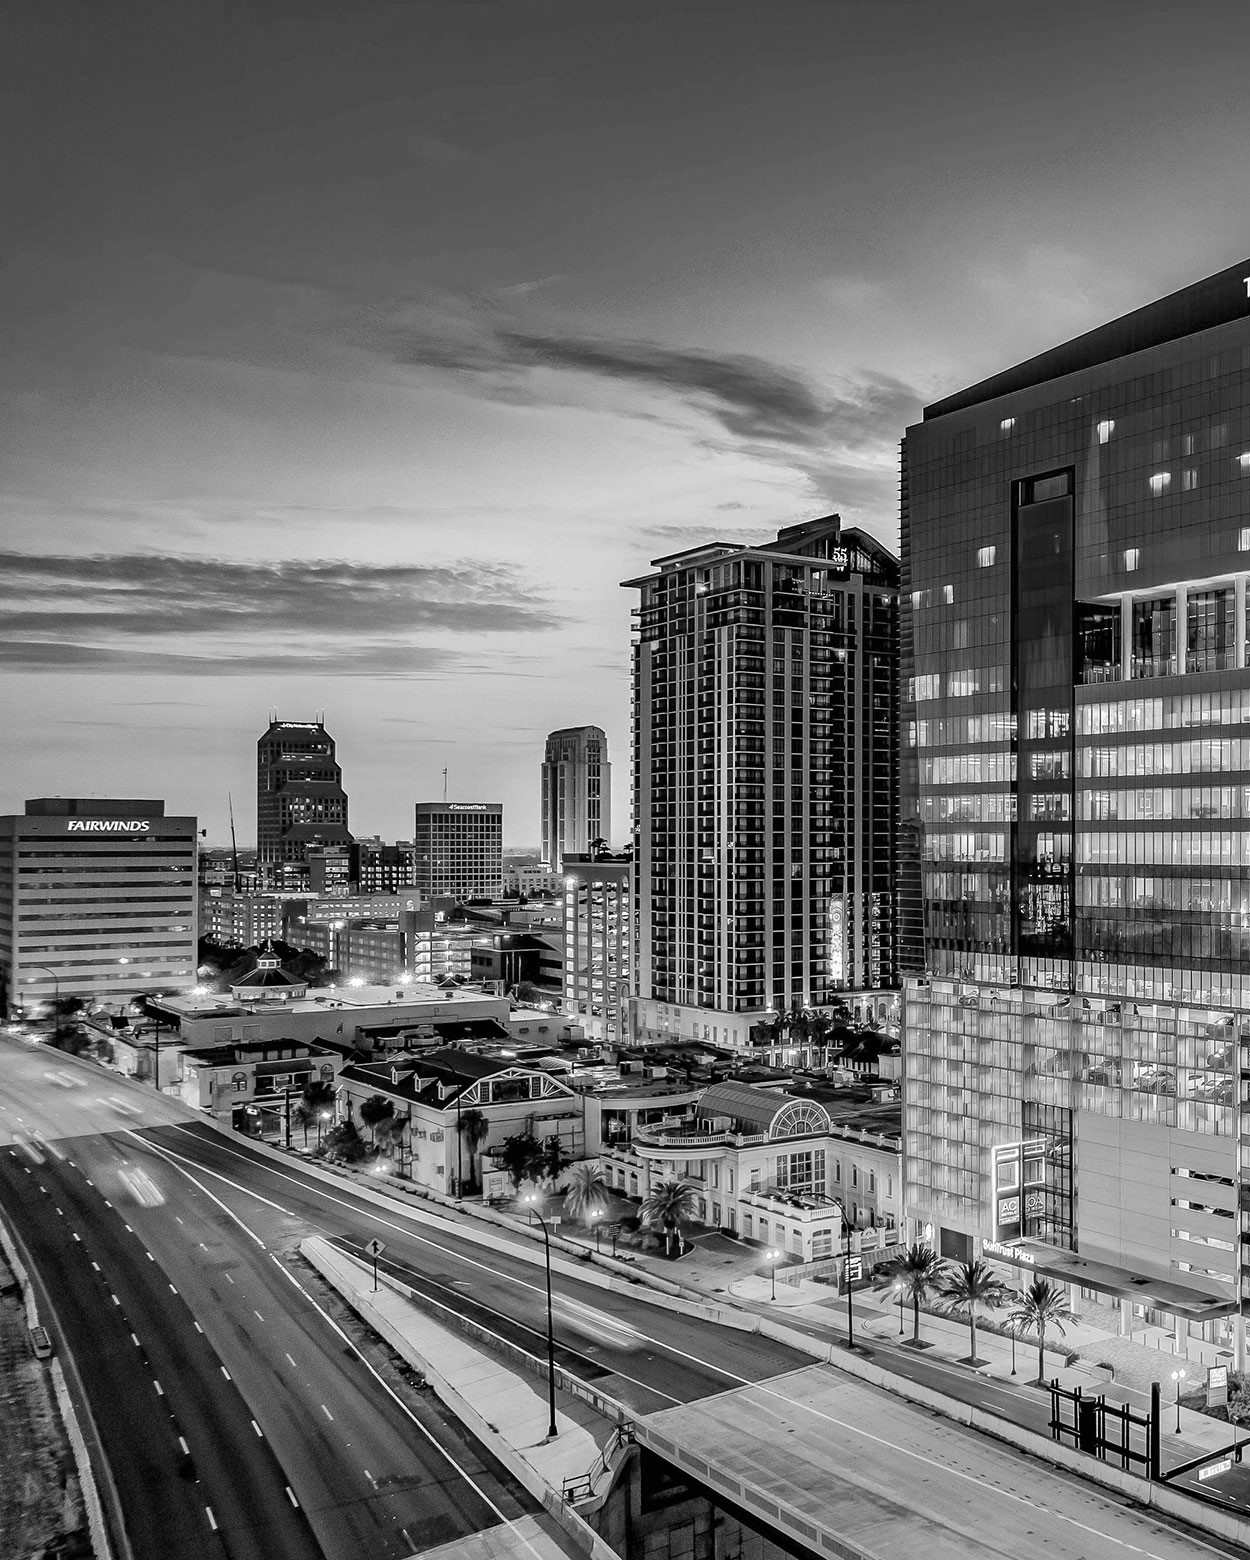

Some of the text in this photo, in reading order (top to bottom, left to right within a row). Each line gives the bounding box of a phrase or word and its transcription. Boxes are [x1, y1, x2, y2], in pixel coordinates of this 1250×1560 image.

[832, 547, 848, 562] 55
[67, 820, 150, 832] FAIRWINDS
[1001, 1201, 1017, 1213] AC
[983, 1239, 1035, 1264] SunTrust Plaza
